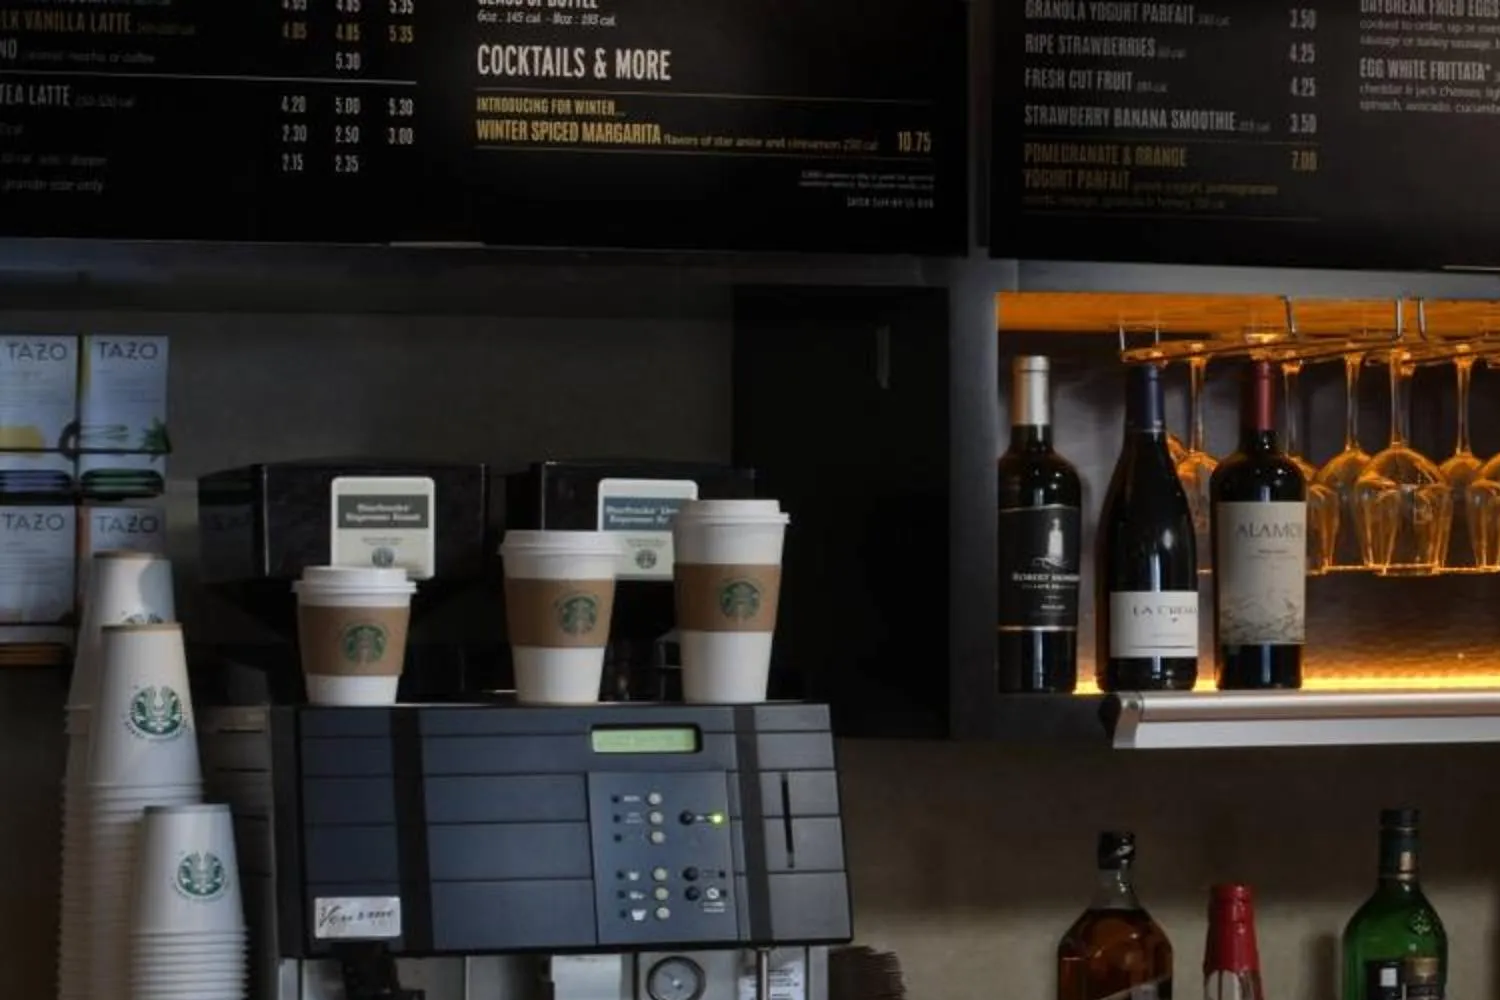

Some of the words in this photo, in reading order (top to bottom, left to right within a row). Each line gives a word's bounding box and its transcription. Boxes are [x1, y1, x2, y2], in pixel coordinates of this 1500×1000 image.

[25, 10, 85, 33] VANILLA
[91, 12, 132, 34] LATTE
[1089, 2, 1138, 23] YOGURT
[1142, 4, 1195, 25] PARFAIT
[1289, 9, 1316, 29] 3.50
[1025, 33, 1055, 54] RIPE
[1058, 35, 1156, 57] STRAWBERRIES
[1289, 42, 1316, 63] 4.25
[476, 44, 585, 79] COCKTAILS
[593, 47, 608, 80] &
[615, 48, 673, 81] MORE
[1359, 57, 1385, 79] EGG
[1387, 58, 1427, 80] WHITE
[1024, 67, 1066, 89] FRESH
[1068, 69, 1093, 90] CUT
[1097, 71, 1133, 92] FRUIT
[1290, 76, 1316, 97] 4.25
[29, 84, 71, 107] LATTE
[476, 95, 549, 114] INTRODUCING
[551, 97, 572, 115] FOR
[1024, 104, 1110, 127] STRAWBERRY
[1113, 106, 1168, 129] BANANA
[1171, 109, 1237, 132] SMOOTHIE
[1290, 113, 1317, 133] 3.50
[335, 125, 360, 144] 2.50
[476, 119, 528, 141] WINTER
[530, 120, 579, 143] SPICED
[581, 122, 662, 145] MARGARITA
[897, 131, 932, 153] 10.75
[1135, 146, 1187, 168] ORANGE
[8, 342, 67, 362] TAZO
[98, 341, 158, 361] TAZO
[1, 512, 65, 533] TAZO
[97, 514, 159, 534] TAZO
